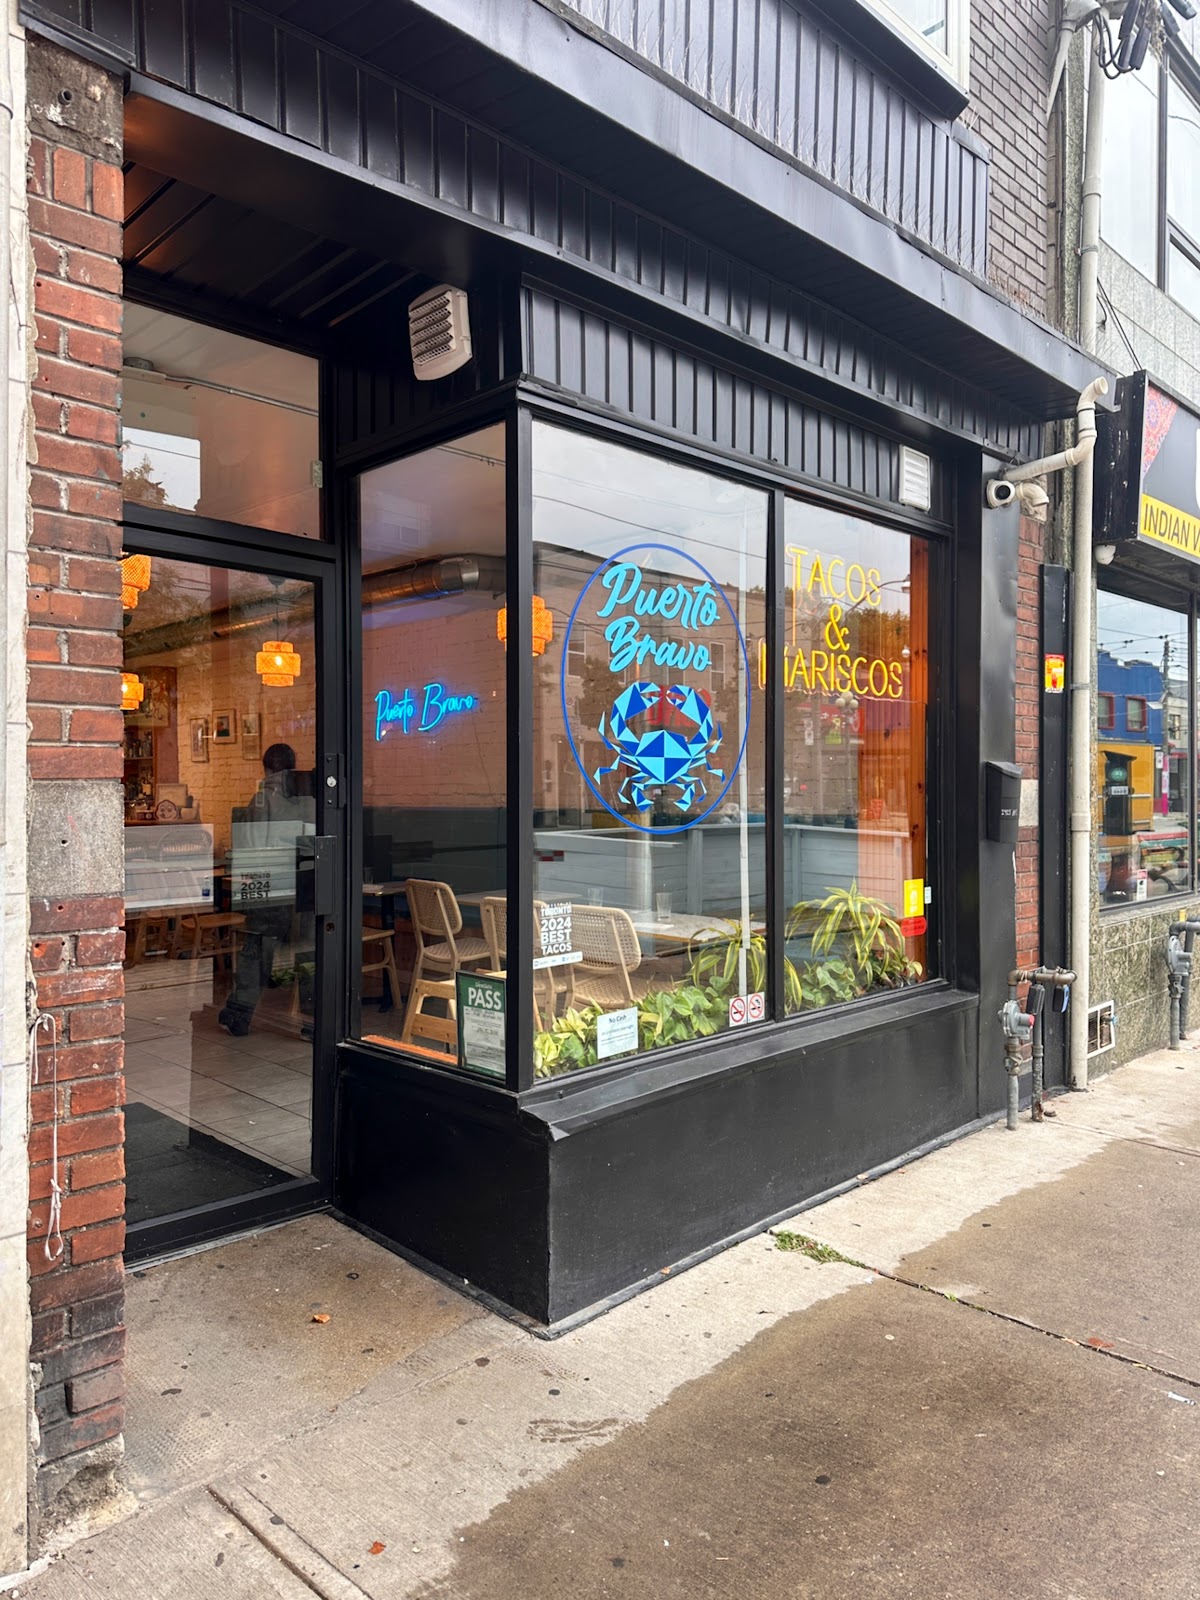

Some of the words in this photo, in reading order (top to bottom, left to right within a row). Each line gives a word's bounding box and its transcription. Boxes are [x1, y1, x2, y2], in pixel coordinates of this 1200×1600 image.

[1143, 502, 1191, 548] INDIAN
[789, 547, 881, 607] TACOS
[596, 562, 721, 631] Puerto
[604, 615, 713, 673] Bravo
[825, 604, 850, 651] &
[374, 688, 415, 741] Puerto
[418, 683, 475, 731] Bravo
[240, 880, 271, 891] 2024
[240, 889, 271, 900] BEST
[540, 916, 572, 931] 2024
[540, 928, 572, 944] BEST
[540, 942, 572, 956] TACOS
[468, 986, 502, 1010] PASS
